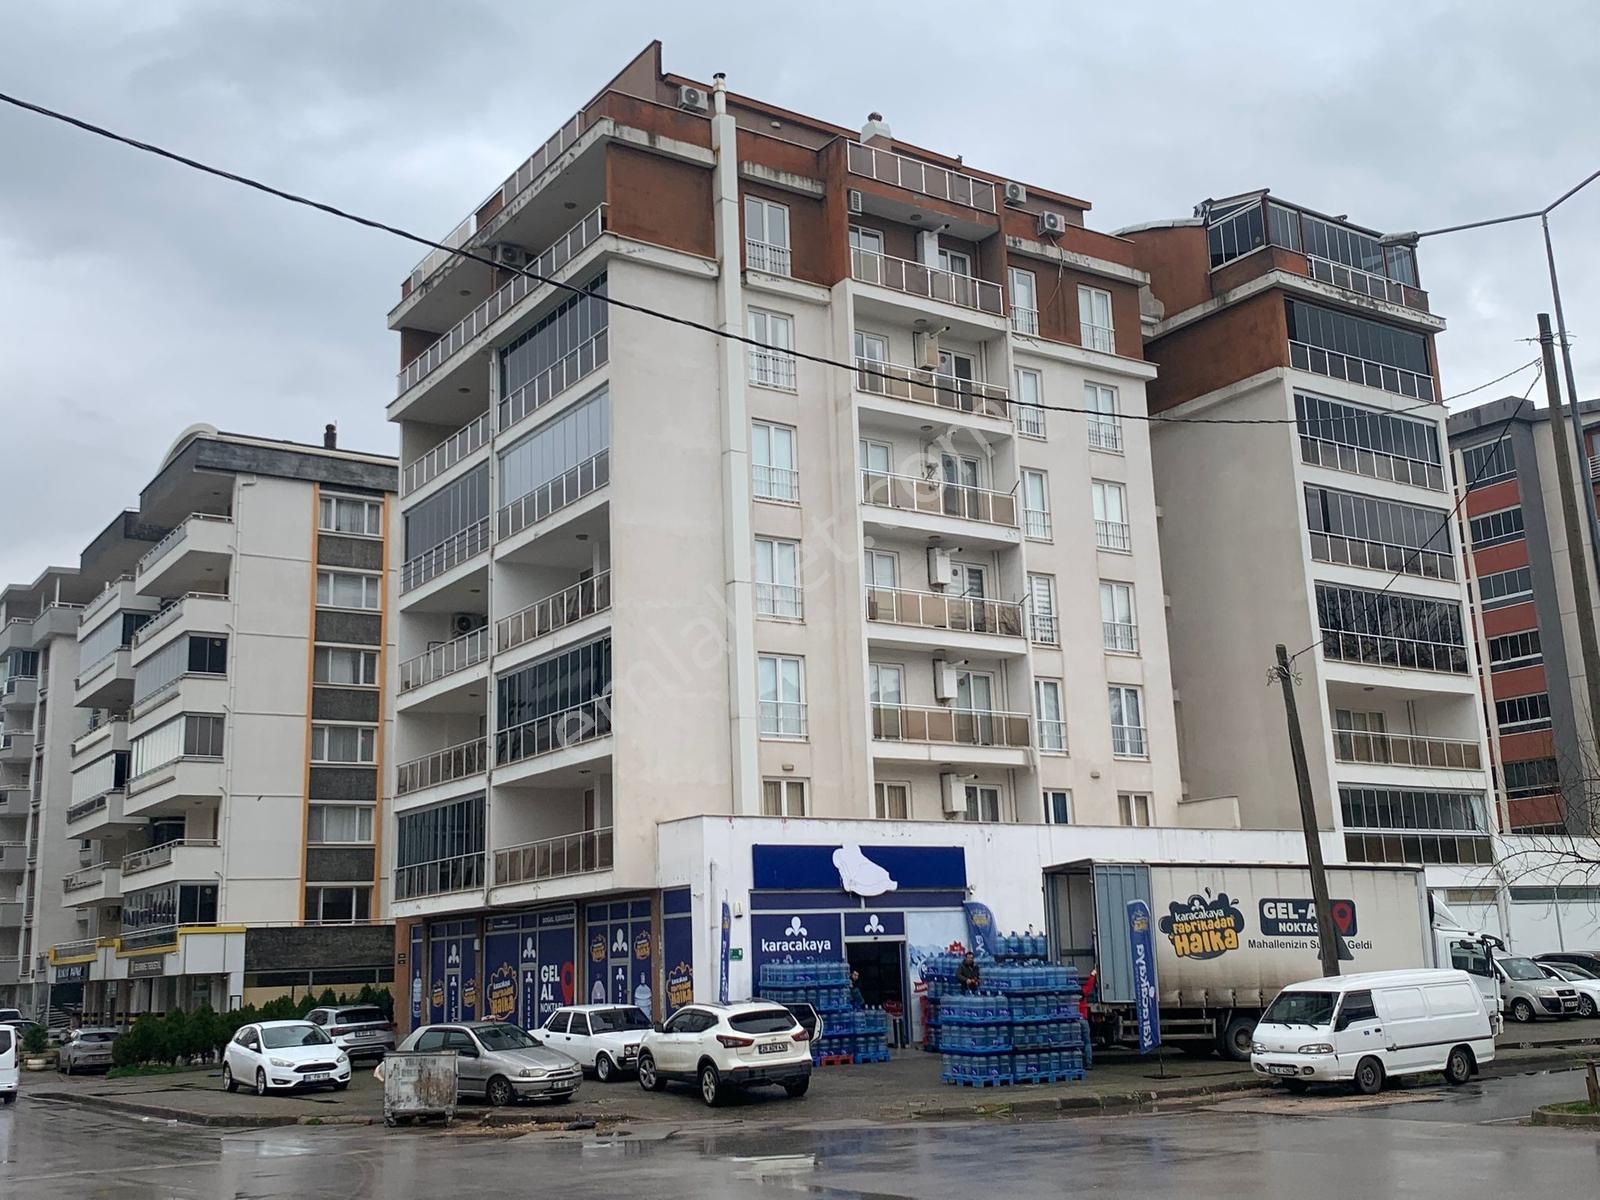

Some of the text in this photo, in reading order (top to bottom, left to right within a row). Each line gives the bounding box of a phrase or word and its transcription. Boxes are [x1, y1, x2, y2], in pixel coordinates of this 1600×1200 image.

[1174, 908, 1224, 922] karacakaya
[1263, 902, 1317, 919] GEL-A
[1278, 922, 1319, 933] NOKTAS
[761, 937, 831, 954] karacakaya
[1248, 939, 1308, 949] Mahallenizin
[1348, 940, 1373, 949] Geldi
[541, 964, 560, 982] GEL
[540, 983, 554, 1001] AL
